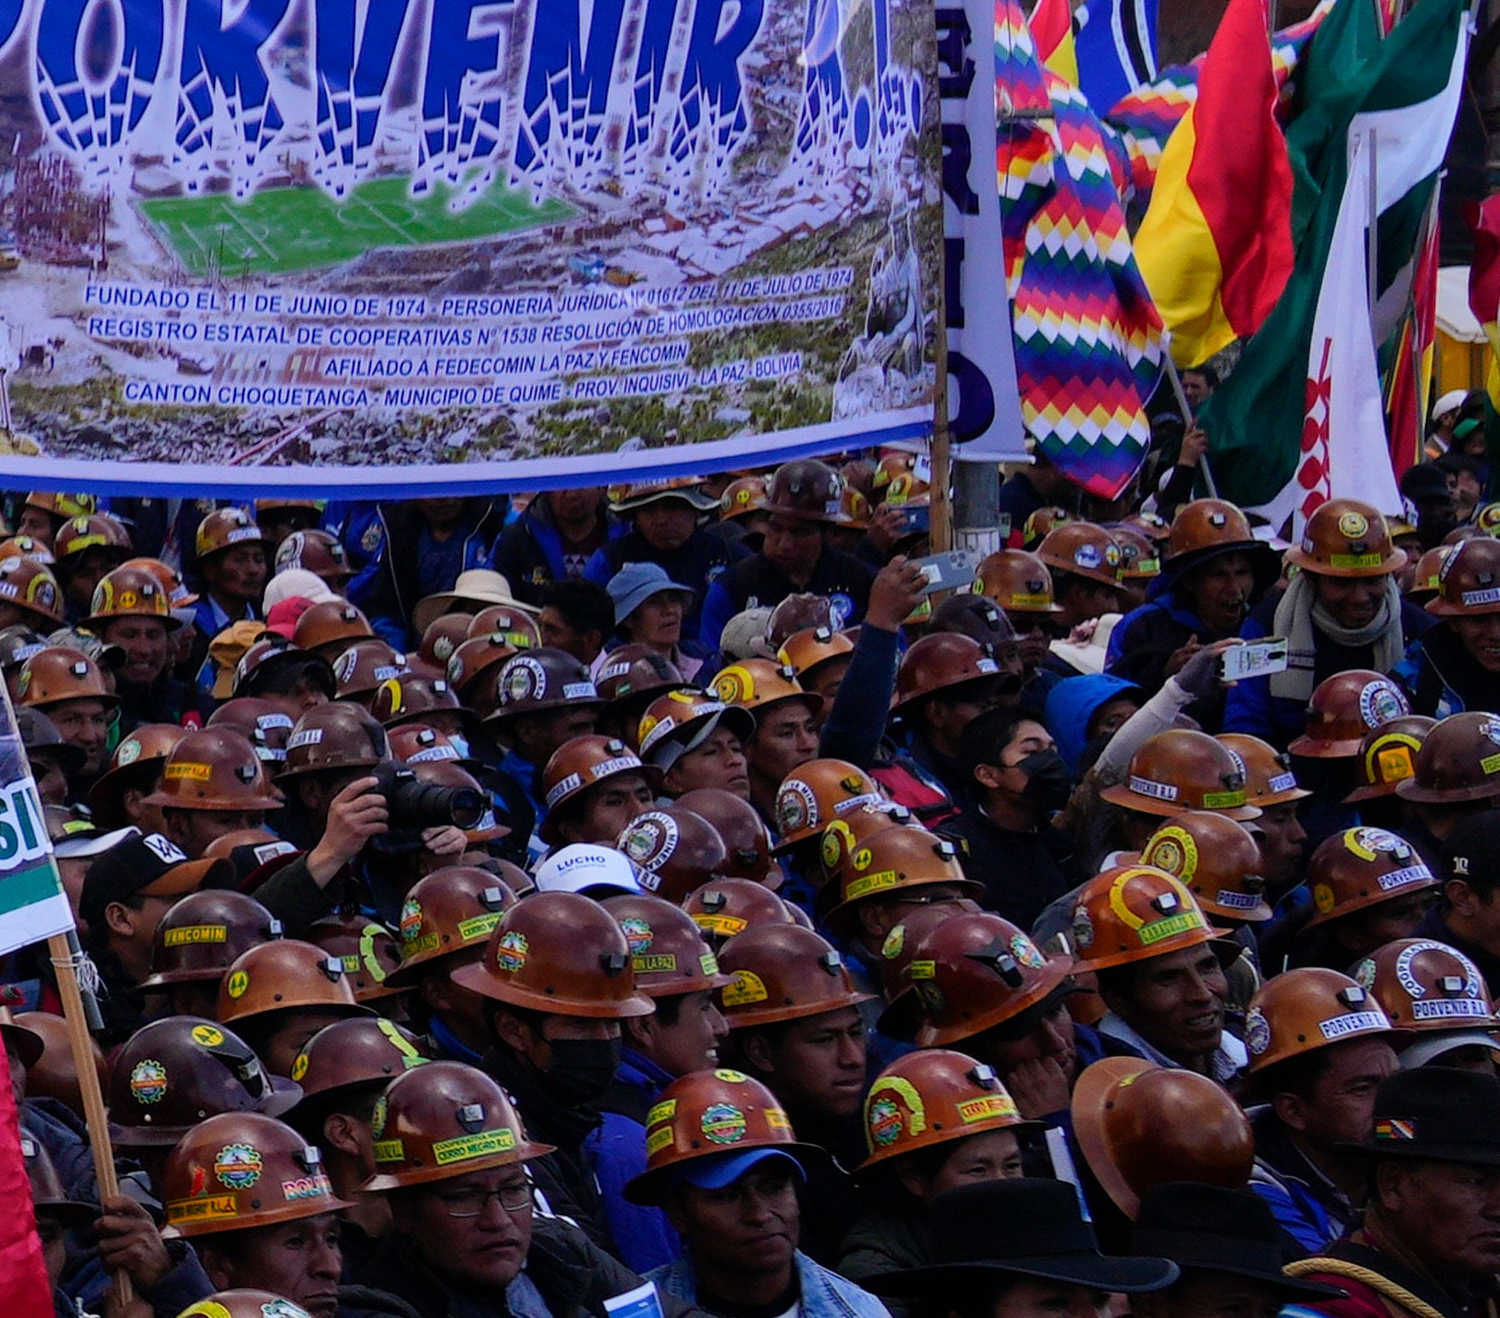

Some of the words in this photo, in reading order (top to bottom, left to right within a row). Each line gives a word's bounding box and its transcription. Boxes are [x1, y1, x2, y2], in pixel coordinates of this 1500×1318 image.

[86, 286, 189, 309] FUNDADO
[196, 292, 222, 312] EL
[228, 294, 247, 312] 11
[254, 295, 283, 313] DE
[288, 296, 348, 315] JUNIO
[353, 297, 379, 316] DE
[385, 299, 426, 316] 1974
[441, 296, 554, 317] PERSONERIA
[689, 283, 718, 302] DEL
[723, 281, 736, 298] 11
[741, 280, 760, 298] DE
[764, 275, 801, 295] JULIO
[804, 272, 824, 292] DE
[825, 269, 853, 289] 1974
[89, 318, 197, 340] REGISTRO
[203, 324, 290, 345] ESTATAL
[297, 327, 323, 346] DE
[328, 328, 472, 347] COOPERATIVAS
[501, 326, 536, 345] 1538
[541, 321, 642, 343] RESOLUCIÓN
[646, 319, 665, 336] DE
[324, 358, 412, 377] AFILIADO
[416, 359, 429, 376] A
[433, 355, 536, 376] FEDECOMIN
[540, 353, 560, 372] LA
[564, 349, 594, 370] PAZ
[598, 348, 608, 367] Y
[611, 343, 688, 366] FENCOMIN
[125, 382, 211, 403] CANTON
[217, 386, 368, 408] CHOQUETANGA
[384, 387, 477, 406] MUNICIPIO
[481, 387, 504, 405] DE
[509, 382, 561, 404] QUIME
[623, 374, 690, 395] INQUISIVI
[700, 369, 718, 386] LA
[721, 364, 746, 383] PAZ
[755, 355, 801, 376] BOLIVIA
[557, 856, 606, 871] LUCHO
[165, 925, 225, 947] FENCOMIN
[437, 1148, 464, 1163] CERRO
[466, 1142, 495, 1159] NEGRO
